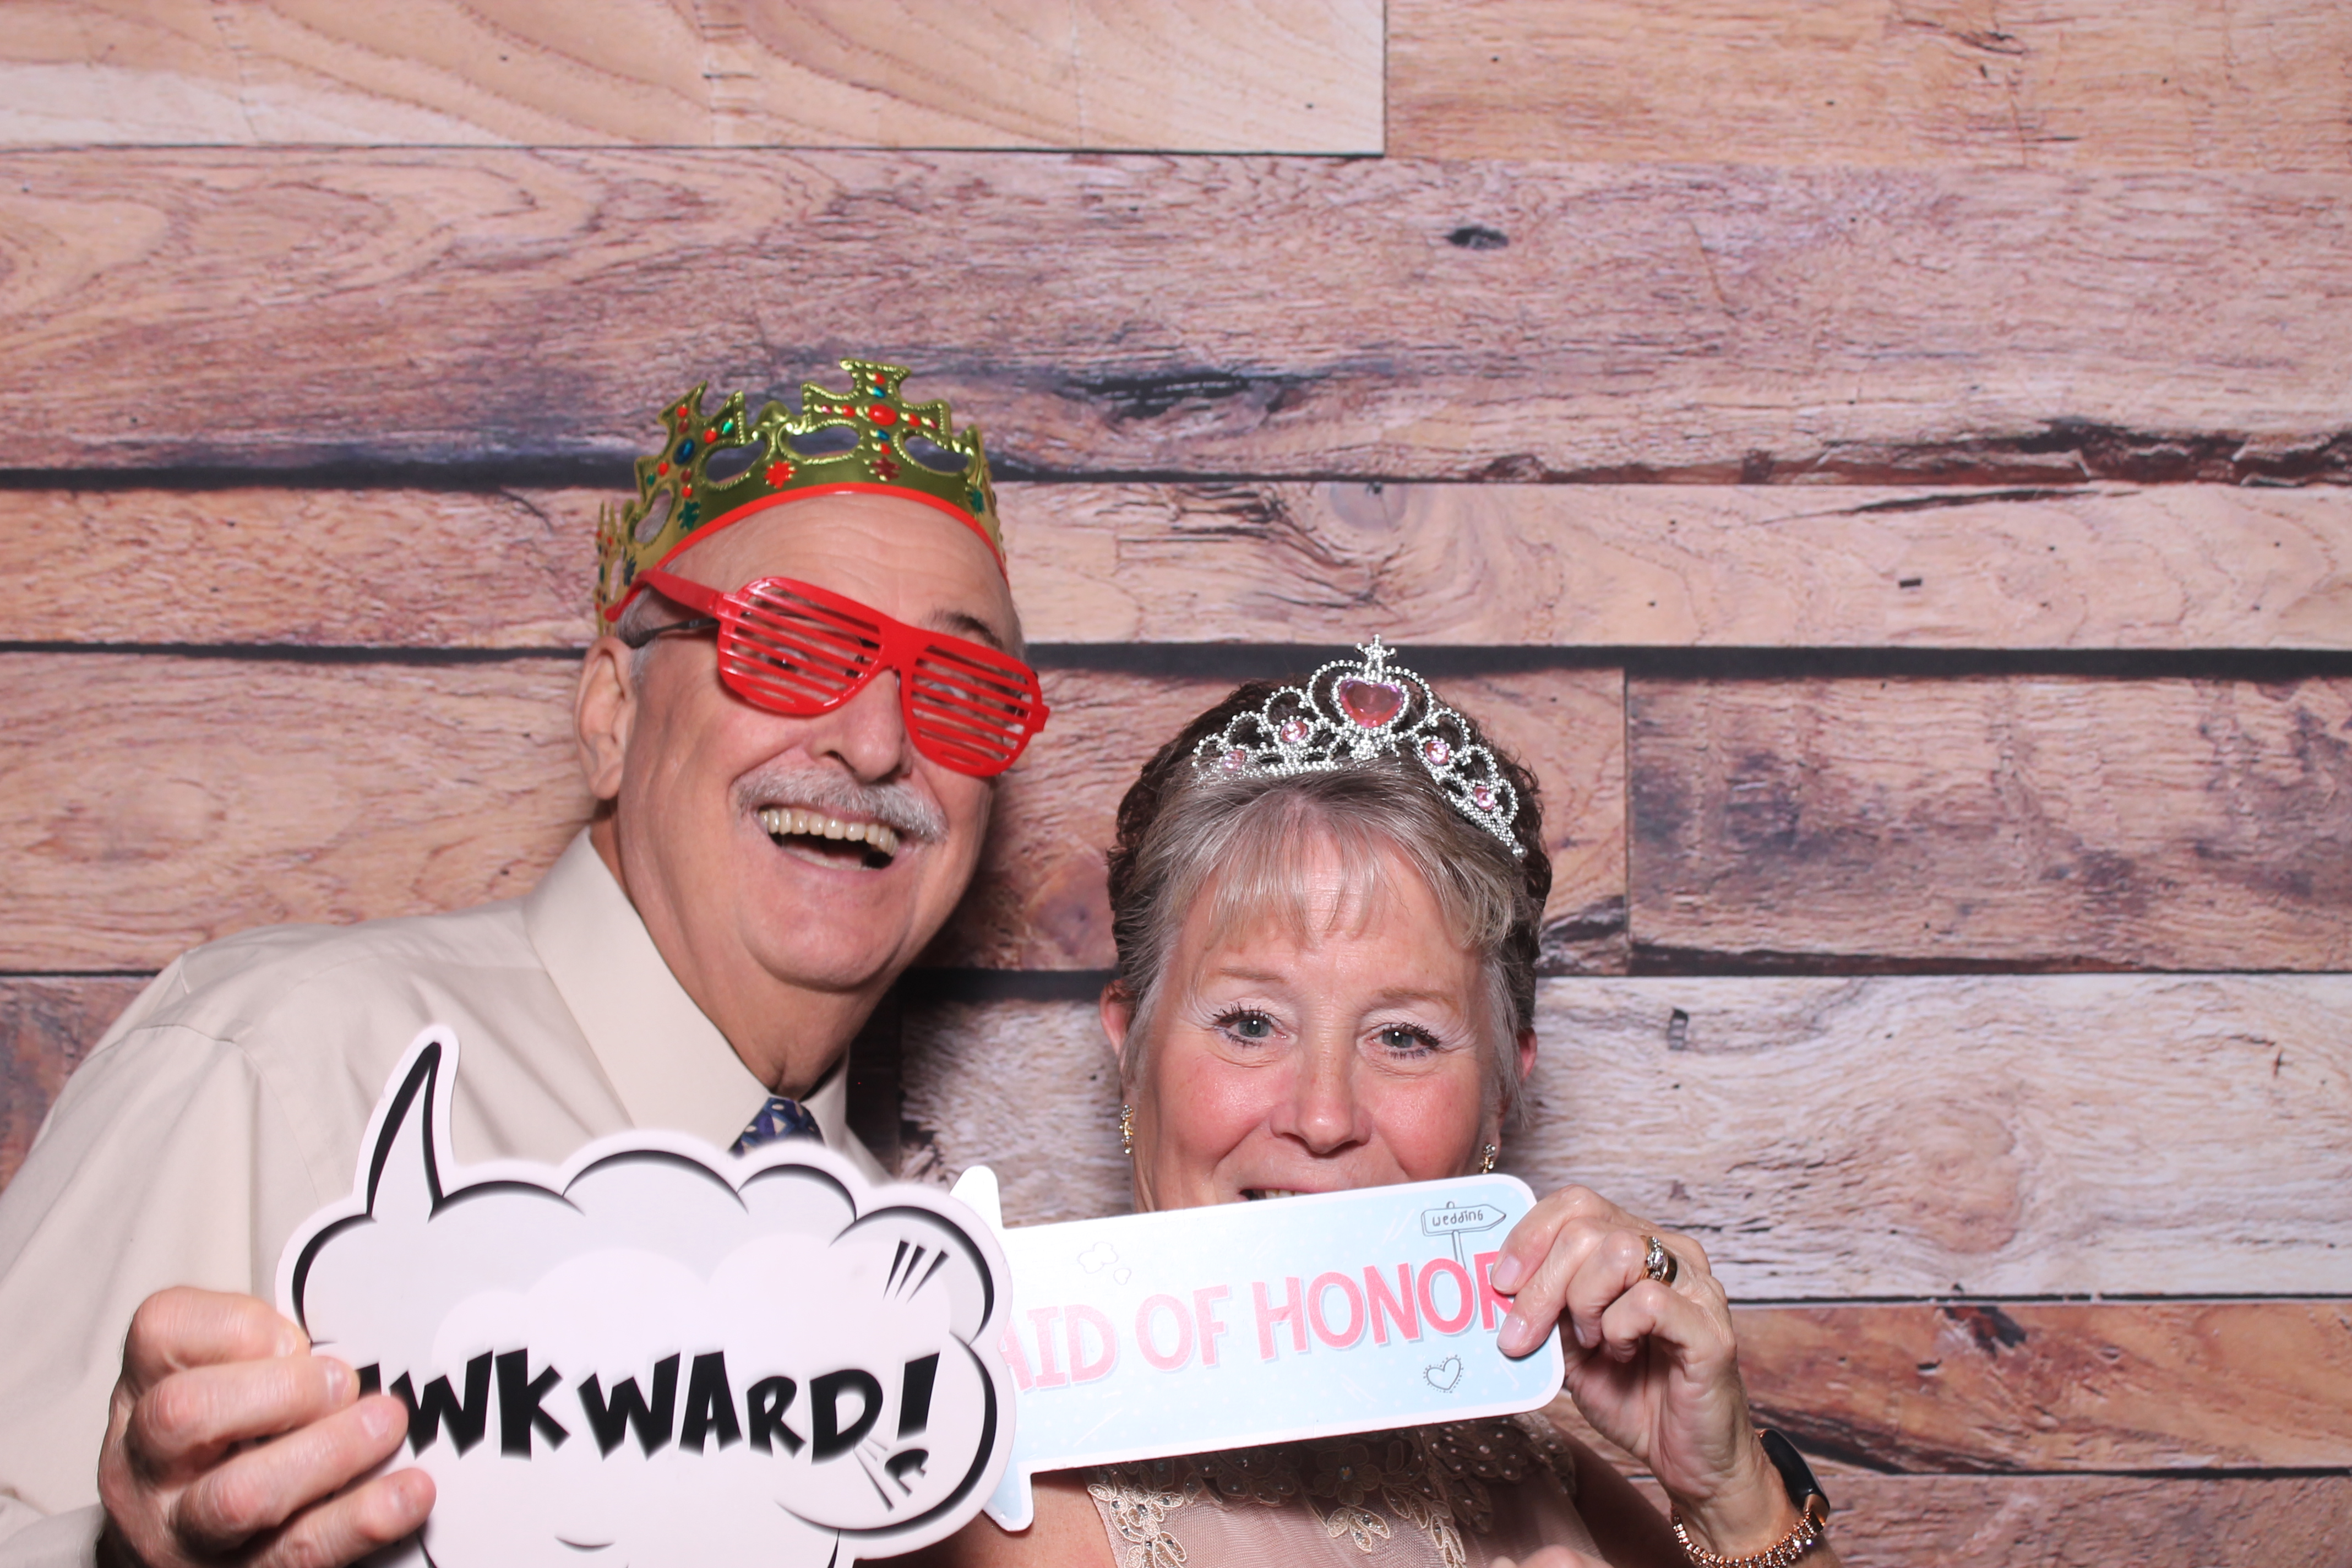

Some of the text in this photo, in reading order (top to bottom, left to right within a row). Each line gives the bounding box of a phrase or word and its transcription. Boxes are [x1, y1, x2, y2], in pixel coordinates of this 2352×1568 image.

[997, 1251, 1513, 1391] AID OF HONOR
[356, 1348, 939, 1482] WKWARD!
